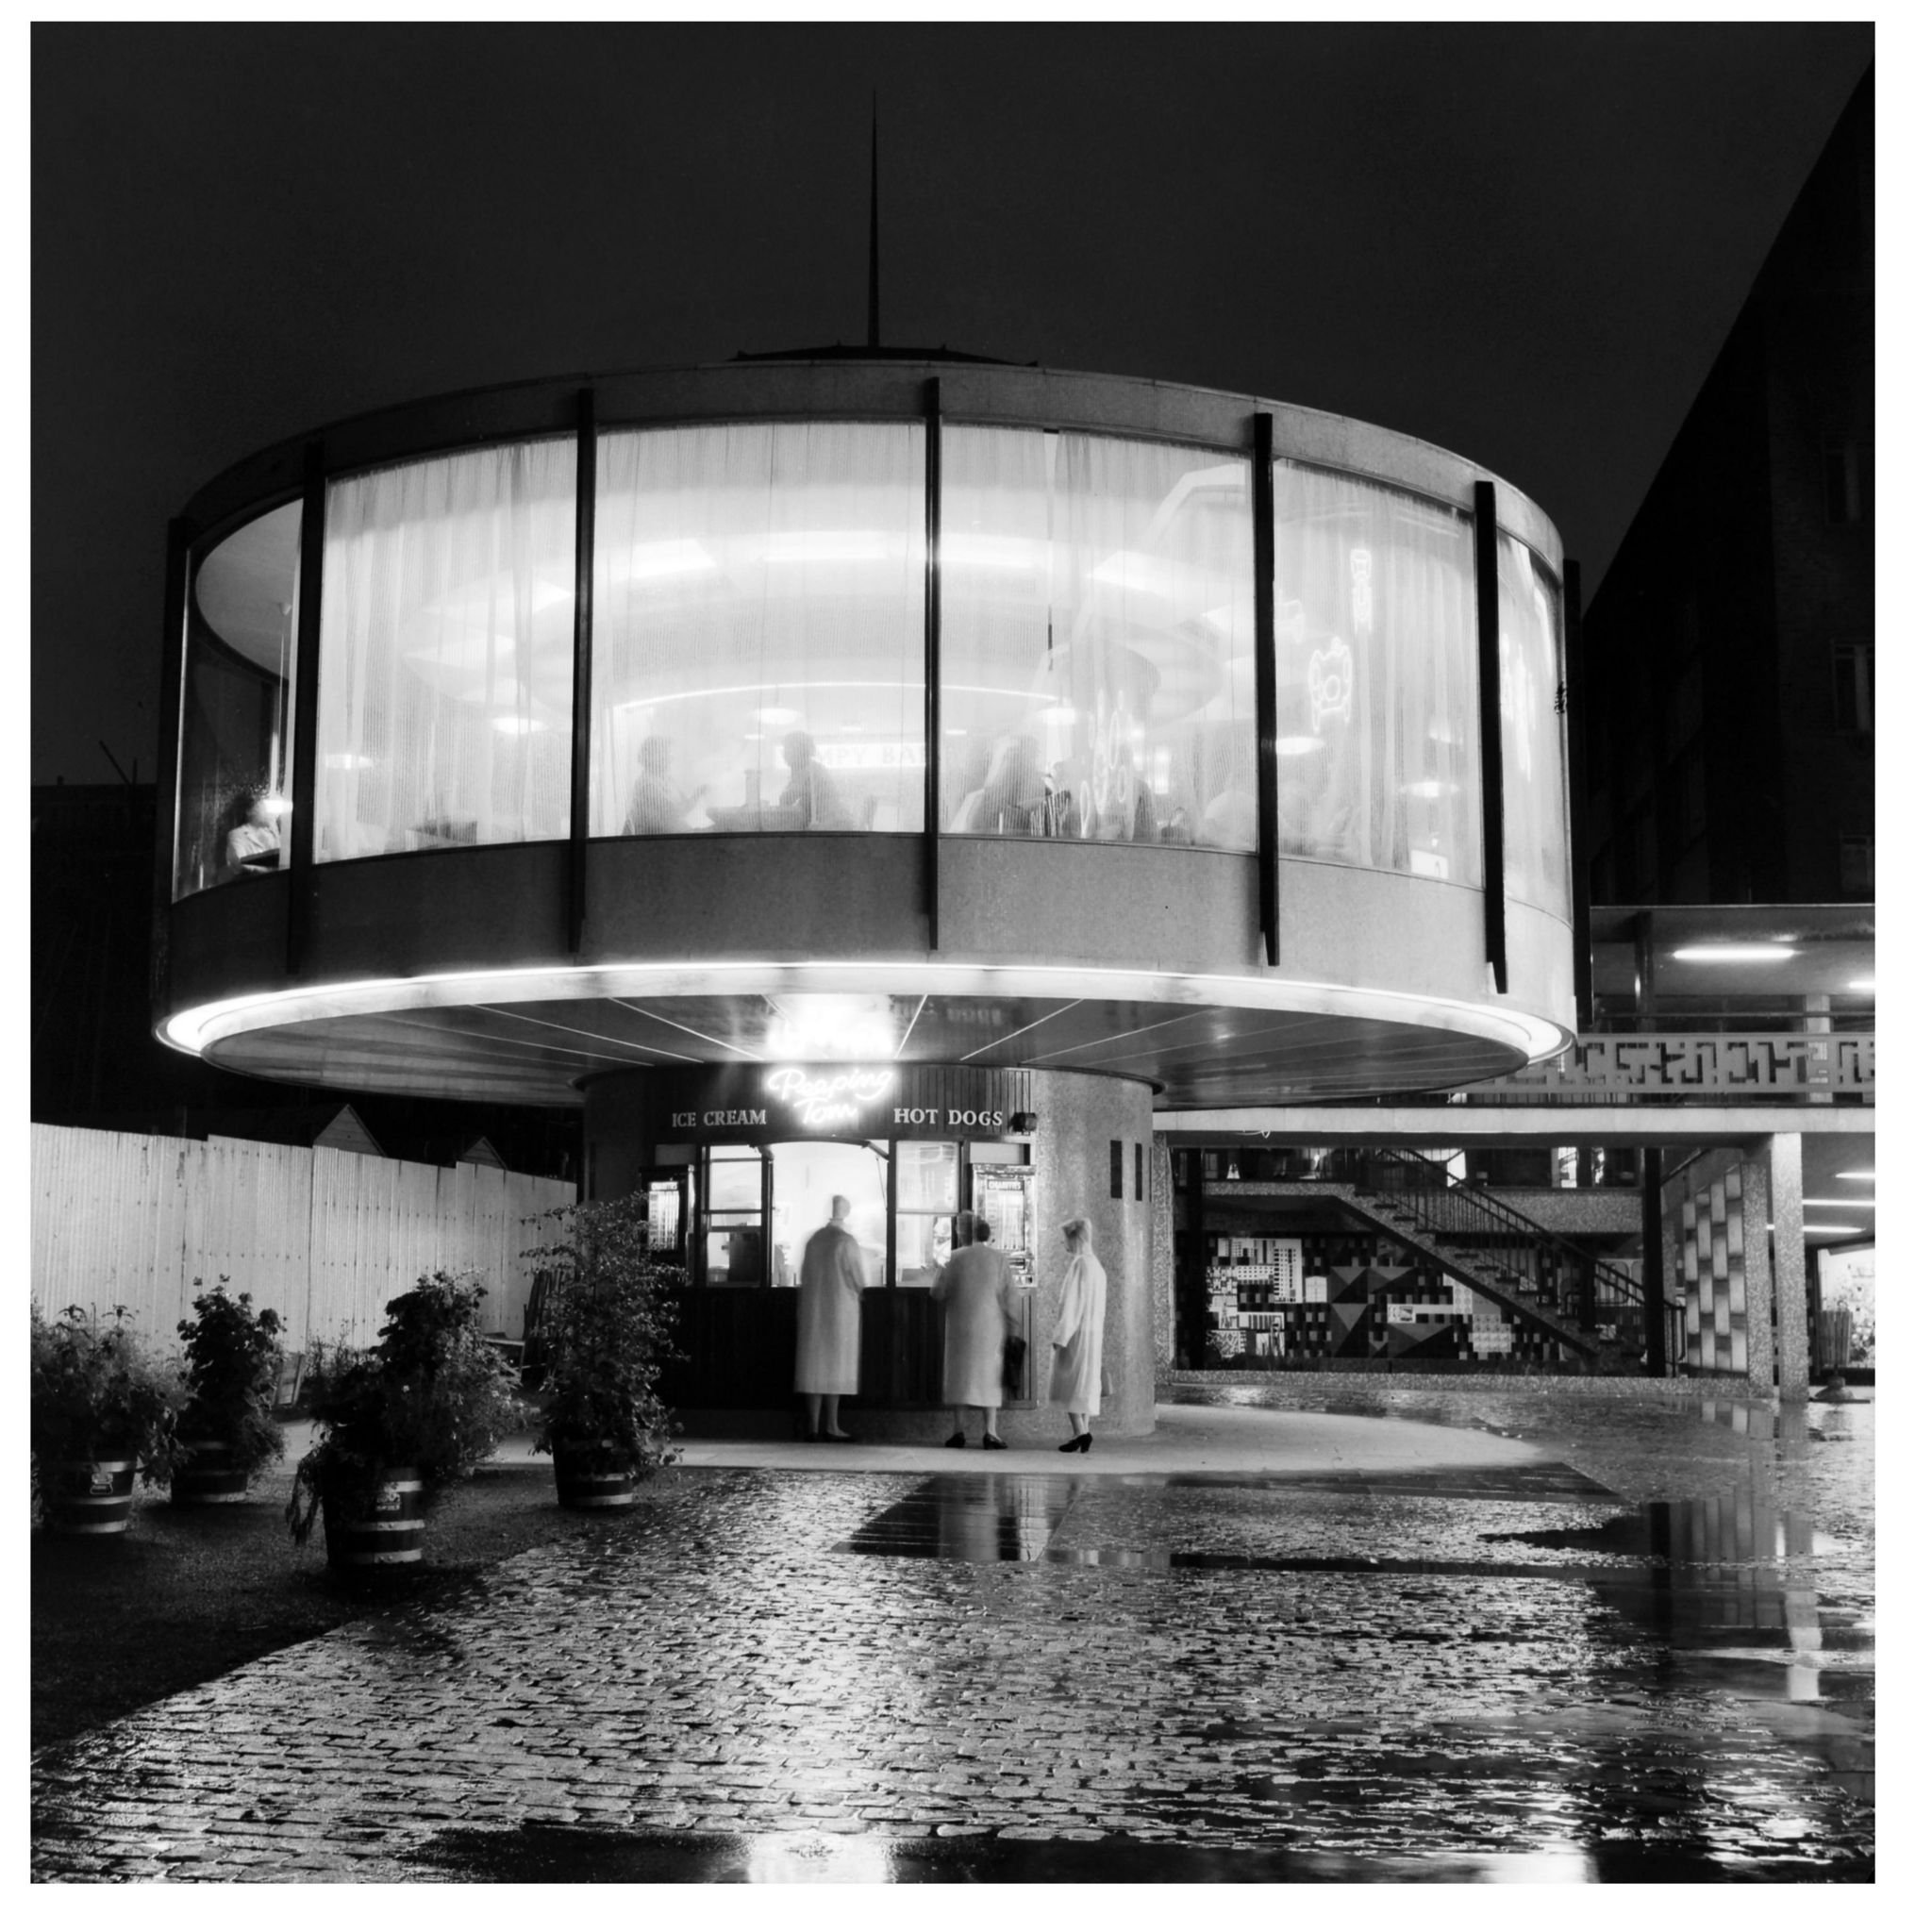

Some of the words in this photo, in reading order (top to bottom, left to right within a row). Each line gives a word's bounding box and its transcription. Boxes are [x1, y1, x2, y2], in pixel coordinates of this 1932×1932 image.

[882, 745, 924, 765] BA
[767, 1068, 893, 1101] Peeping
[672, 1112, 696, 1127] ICE
[703, 1109, 767, 1126] CREAM
[792, 1097, 859, 1124] Tom
[893, 1108, 939, 1124] HOT
[948, 1109, 1003, 1126] DOGS
